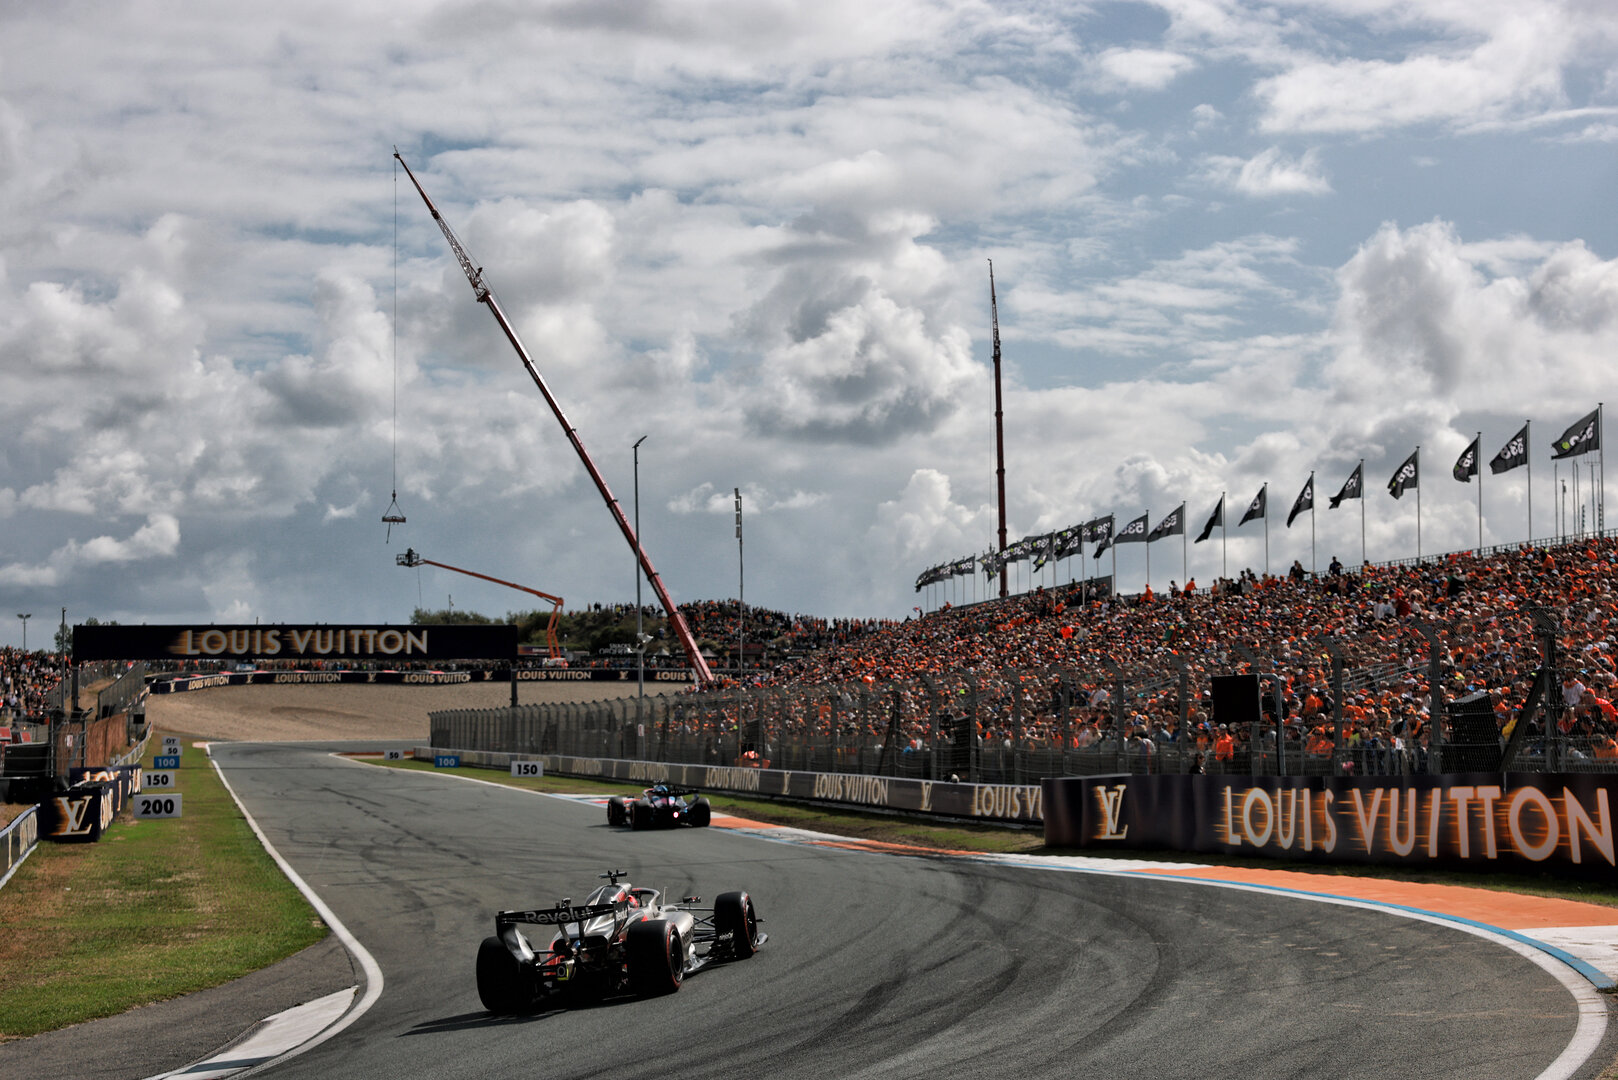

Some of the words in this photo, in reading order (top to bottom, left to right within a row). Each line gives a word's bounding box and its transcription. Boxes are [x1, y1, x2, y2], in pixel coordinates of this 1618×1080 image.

[185, 629, 281, 655] LOUIS
[292, 629, 428, 655] VUITTON
[275, 673, 301, 683] LOUIS
[302, 673, 341, 683] VUITTON
[404, 674, 435, 683] LOUIS
[517, 671, 546, 680] LOUIS
[549, 671, 591, 680] VUITTON
[656, 671, 688, 681] LOUIS
[158, 758, 176, 767] 100
[439, 758, 455, 766] 100
[517, 764, 538, 774] 150
[147, 775, 169, 786] 150
[706, 767, 730, 788] LOUIS
[815, 774, 842, 800] LOUIS
[845, 776, 889, 805] VUITTON
[974, 784, 1021, 818] LOUIS
[141, 799, 174, 815] 200
[1226, 786, 1337, 853] LOUIS
[1351, 785, 1616, 867] VUITTON
[524, 906, 593, 924] Revolut
